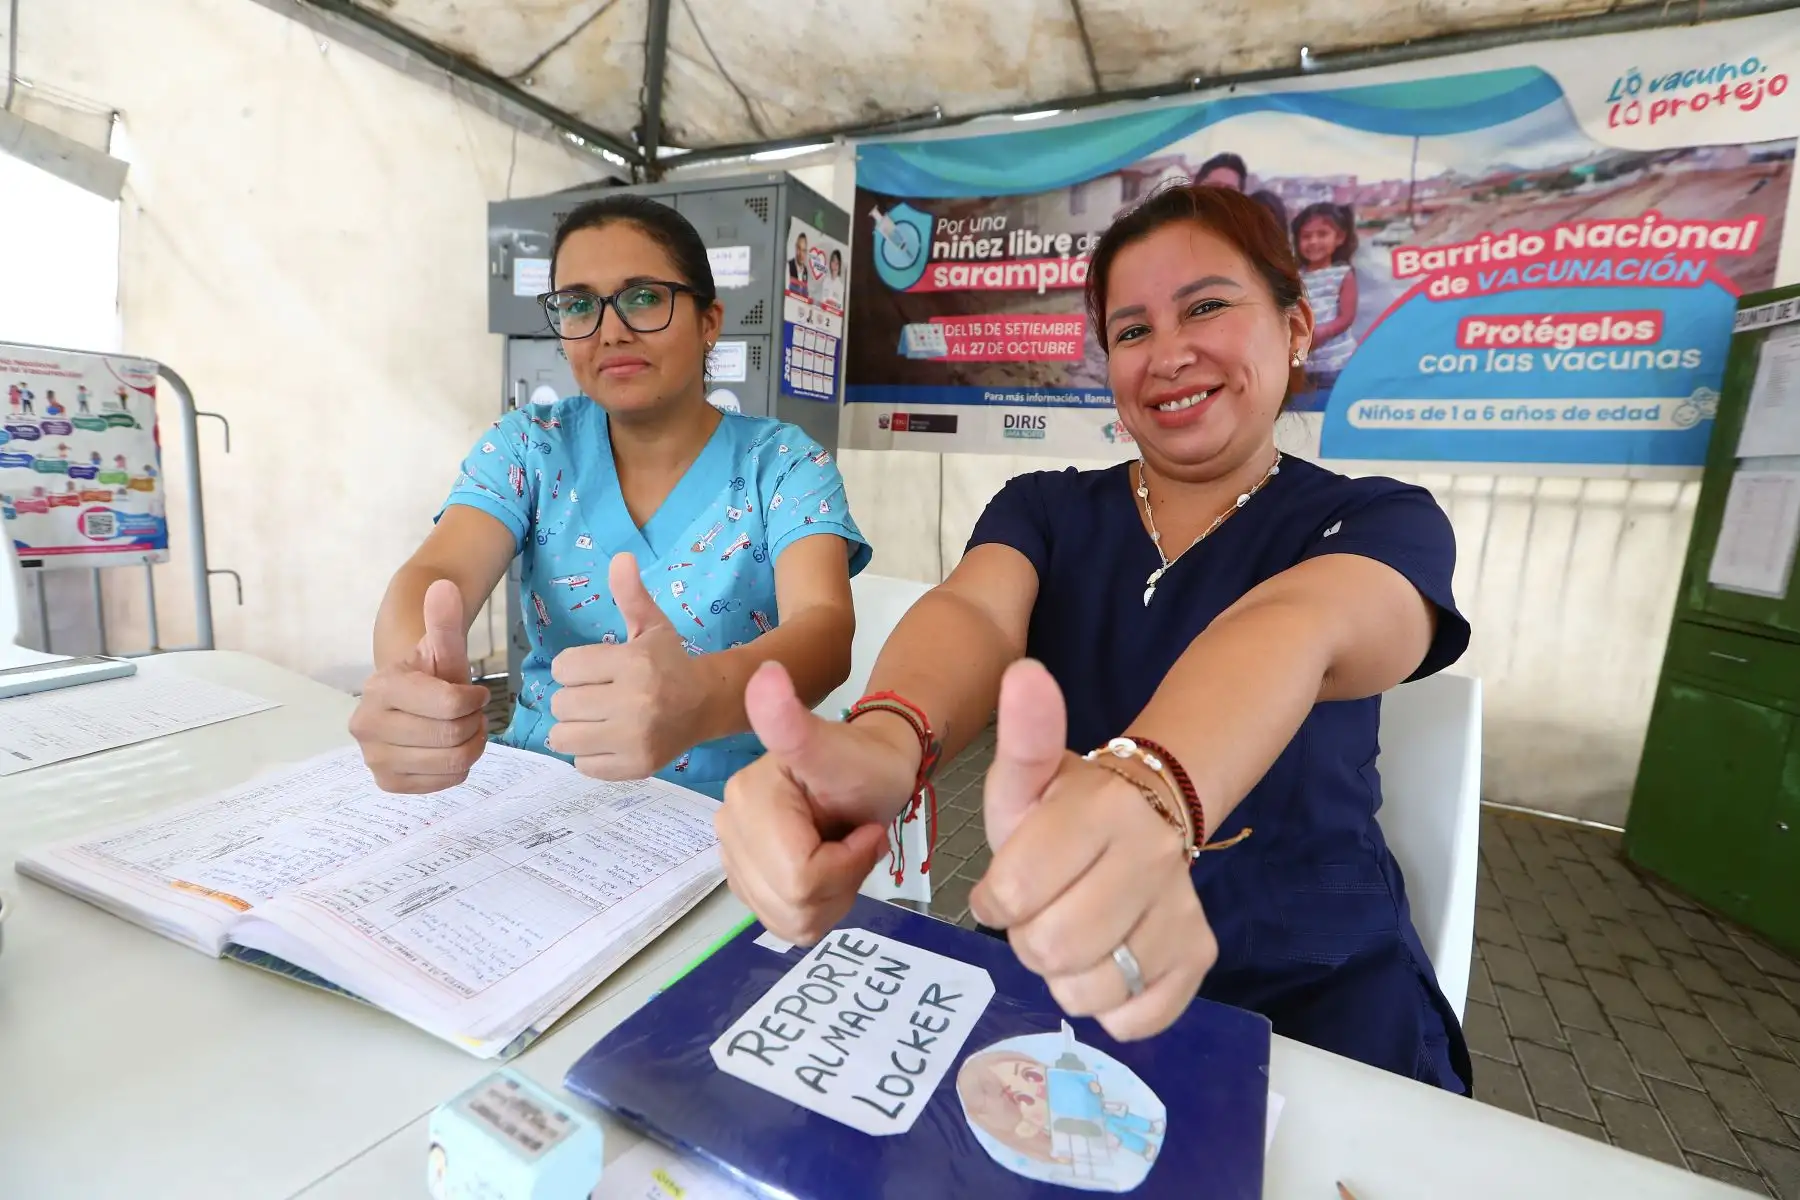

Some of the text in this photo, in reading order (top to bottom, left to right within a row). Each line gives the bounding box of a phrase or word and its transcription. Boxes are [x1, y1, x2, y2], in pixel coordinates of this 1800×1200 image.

[1648, 74, 1788, 125] protejo
[936, 215, 1007, 235] Por una
[932, 234, 1004, 259] niñez
[1008, 229, 1073, 256] libre
[1396, 216, 1759, 276] Barrido Nacional
[933, 251, 1090, 294] sarampió
[1429, 252, 1708, 297] de VACUNACIÓN
[944, 322, 1082, 336] DEL 15 DE SETIEMBRE
[1464, 316, 1656, 350] Protégelos
[951, 341, 1076, 355] AL 27 DE OCTUBRE
[1418, 348, 1702, 373] con las vacunas
[984, 391, 1004, 401] Para
[1006, 392, 1025, 401] más
[1026, 393, 1082, 404] información,
[1359, 404, 1661, 421] Niños de 1 a 6 años de edad
[1004, 414, 1046, 429] DIRIS
[727, 932, 880, 1067] REPORTE
[795, 956, 911, 1094] ALMACEN
[852, 982, 963, 1119] LOCKER
